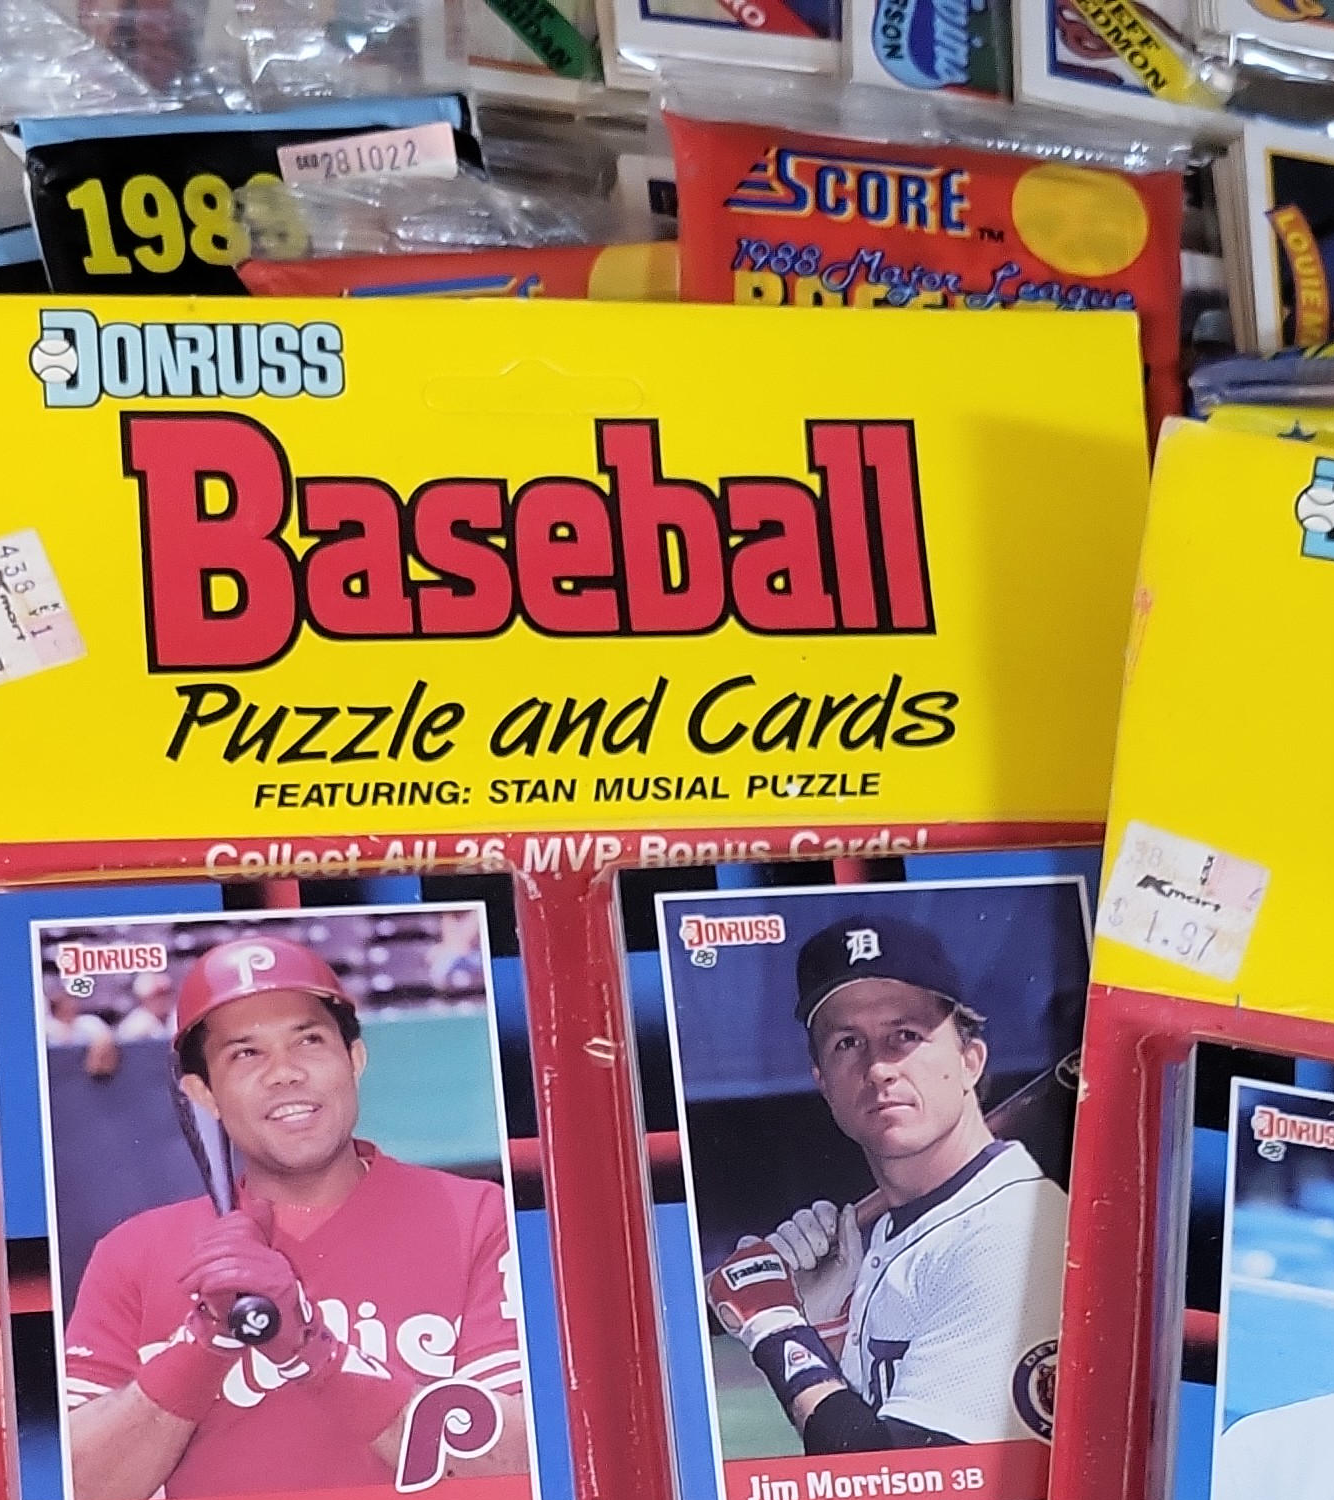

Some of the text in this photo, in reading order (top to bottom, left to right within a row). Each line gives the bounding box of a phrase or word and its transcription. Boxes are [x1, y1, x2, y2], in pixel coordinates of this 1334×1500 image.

[320, 140, 419, 180] 281022
[724, 147, 972, 236] SCORE
[734, 238, 819, 275] 1988
[824, 247, 962, 306] Major
[29, 308, 346, 409] DONRUSS
[119, 410, 938, 674] Baseball
[0, 545, 35, 594] 438
[166, 673, 960, 766] Puzzle and Cards
[254, 772, 881, 809] FEATURING: STAN MUSIAL PUZZLE
[205, 829, 931, 880] Collect All 26 MVP Bonus Cards!
[683, 916, 782, 948] DONRUSS
[61, 944, 164, 977] DONRUSS
[727, 1256, 783, 1286] Franklin
[241, 1309, 271, 1337] 16
[806, 1466, 943, 1500] Morrison
[951, 1467, 984, 1491] 3B
